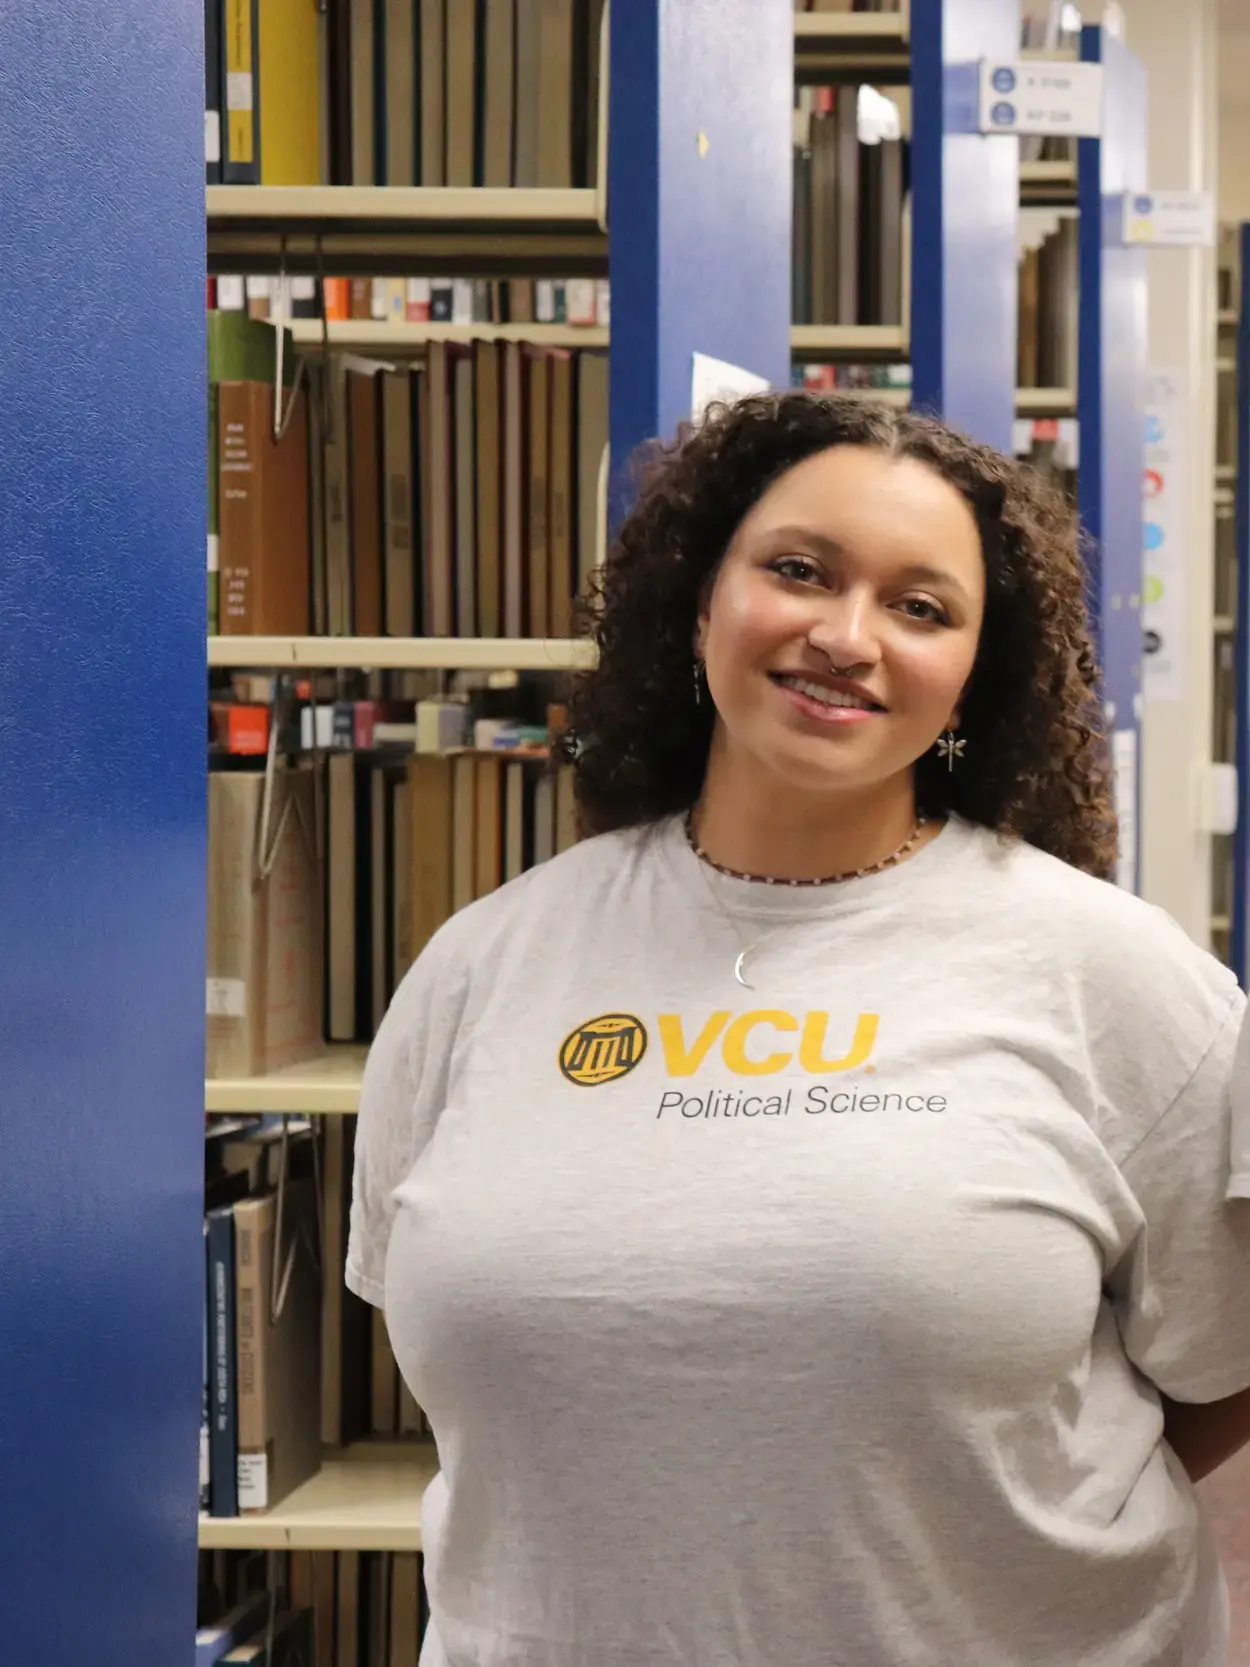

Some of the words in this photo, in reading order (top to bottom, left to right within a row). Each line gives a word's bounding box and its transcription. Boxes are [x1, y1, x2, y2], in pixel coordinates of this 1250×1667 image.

[657, 1009, 879, 1077] VCU
[656, 1088, 793, 1120] Political
[804, 1085, 947, 1115] Science
